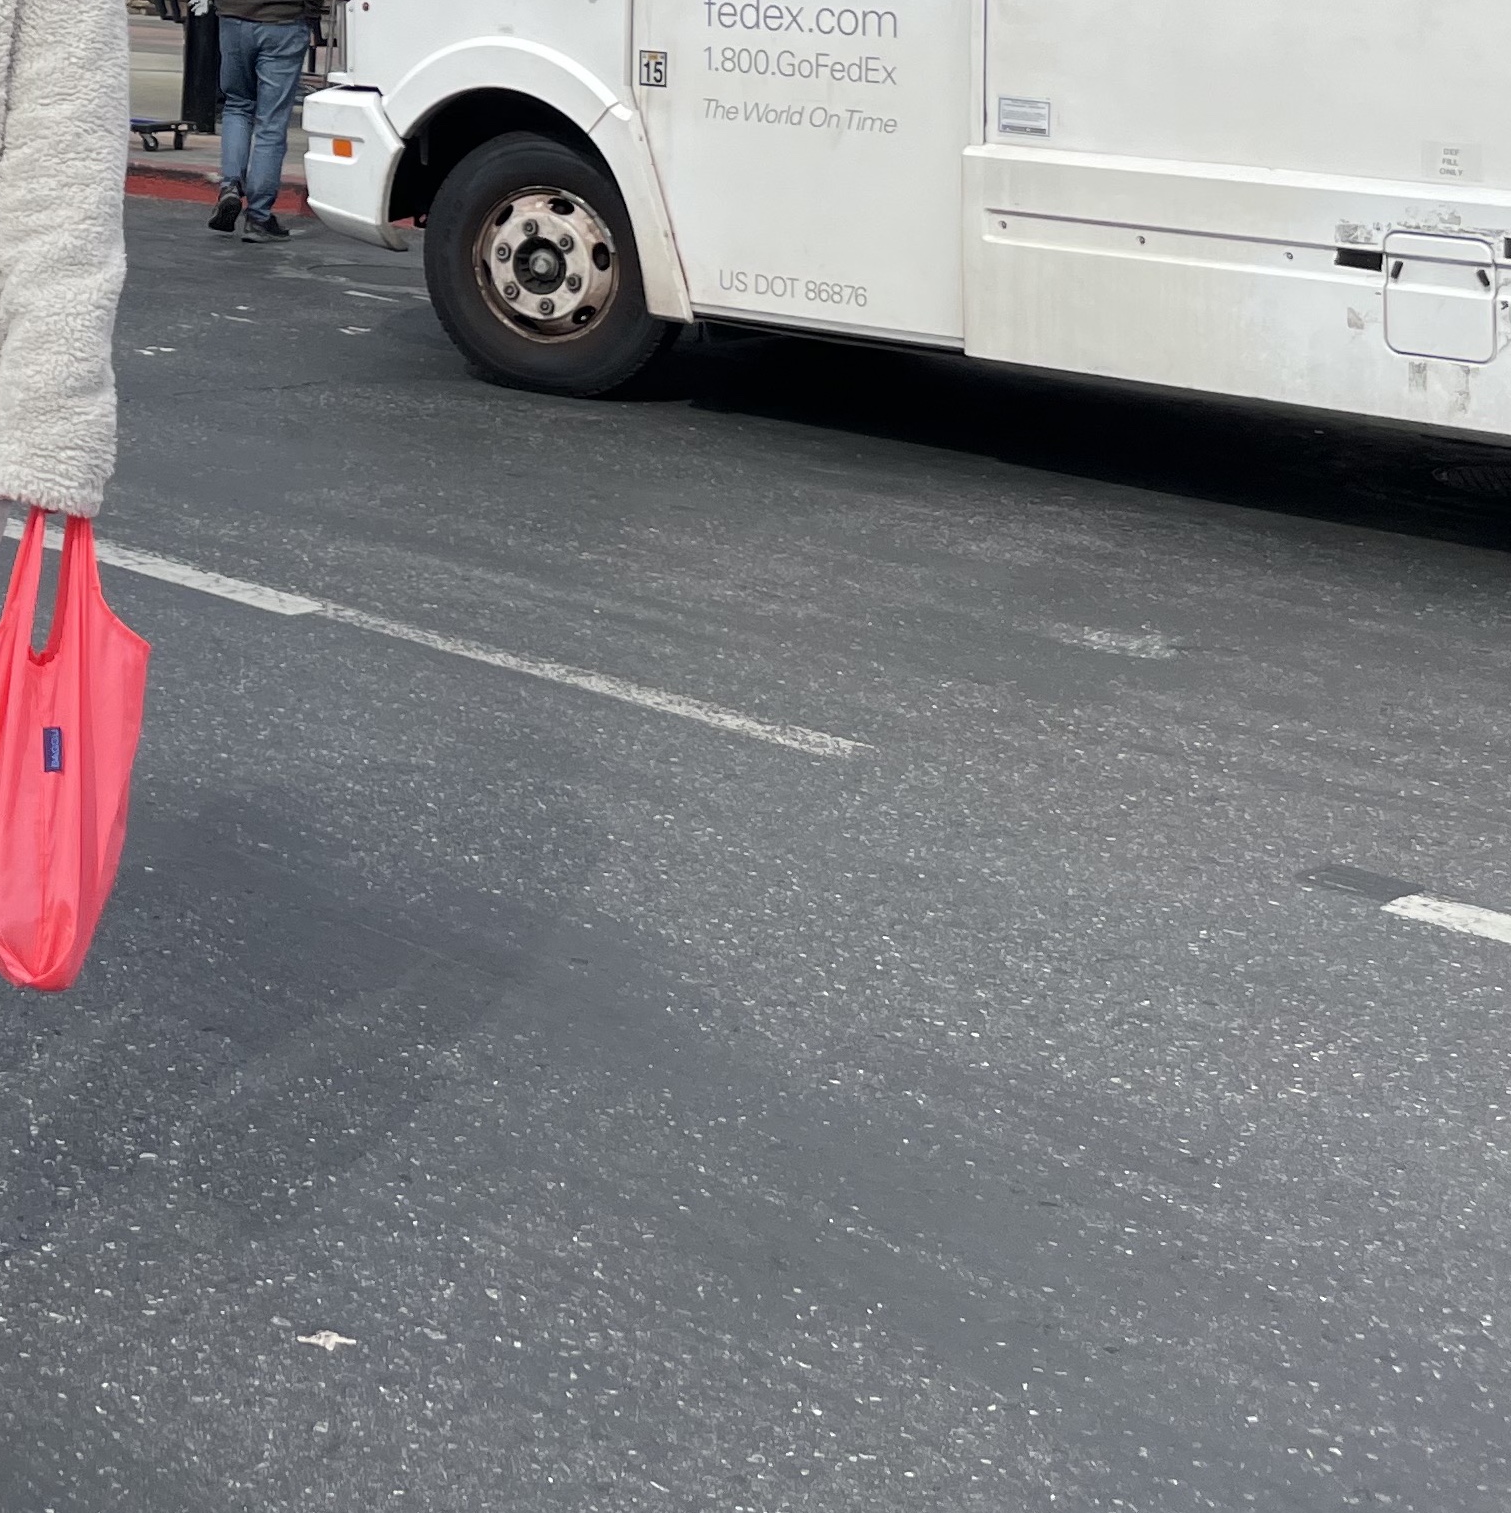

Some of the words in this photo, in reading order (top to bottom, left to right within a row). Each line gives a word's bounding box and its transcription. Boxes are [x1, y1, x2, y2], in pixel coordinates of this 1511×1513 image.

[643, 60, 663, 83] 15
[703, 46, 897, 86] 1.800.GoFedEx
[702, 97, 739, 122] The
[743, 101, 805, 126] World
[809, 106, 840, 129] On
[844, 108, 898, 134] Time
[719, 269, 748, 293] US
[754, 273, 800, 299] DOT
[804, 280, 868, 308] 86876
